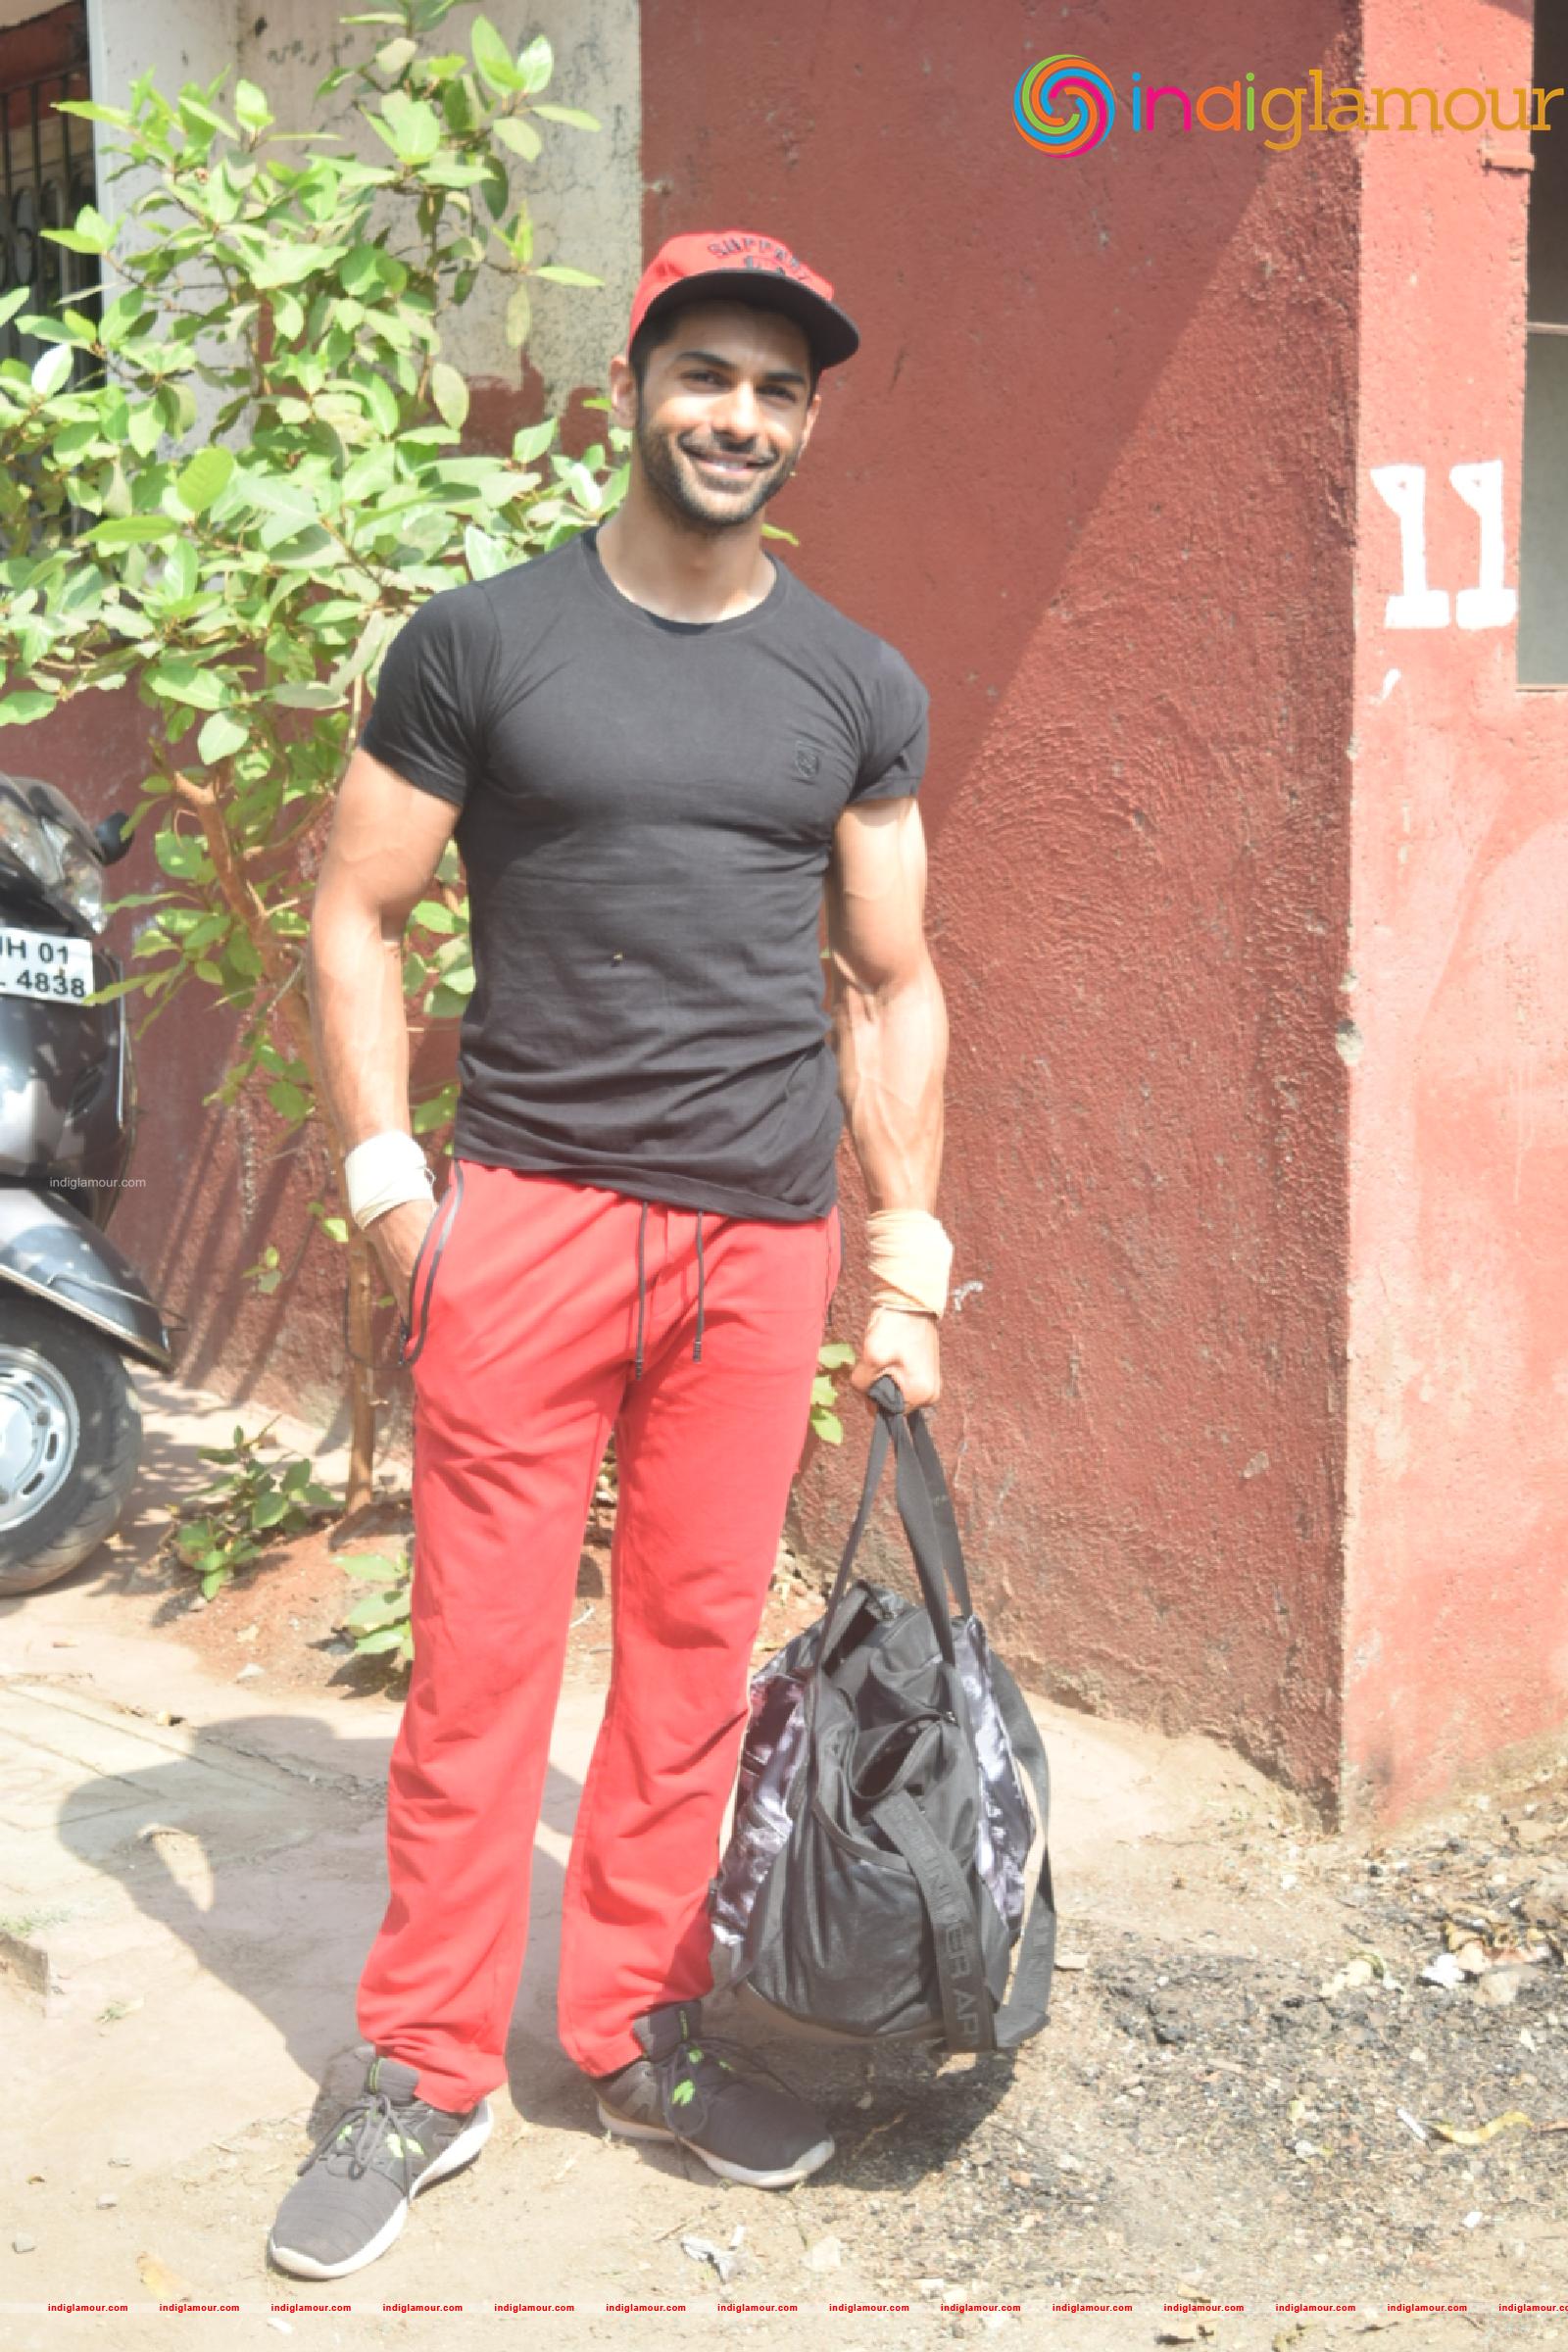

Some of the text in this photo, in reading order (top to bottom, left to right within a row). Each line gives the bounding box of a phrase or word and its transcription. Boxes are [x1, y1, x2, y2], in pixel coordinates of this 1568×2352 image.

[1370, 459, 1518, 630] 11
[38, 942, 69, 964] 01
[17, 969, 85, 998] 4838
